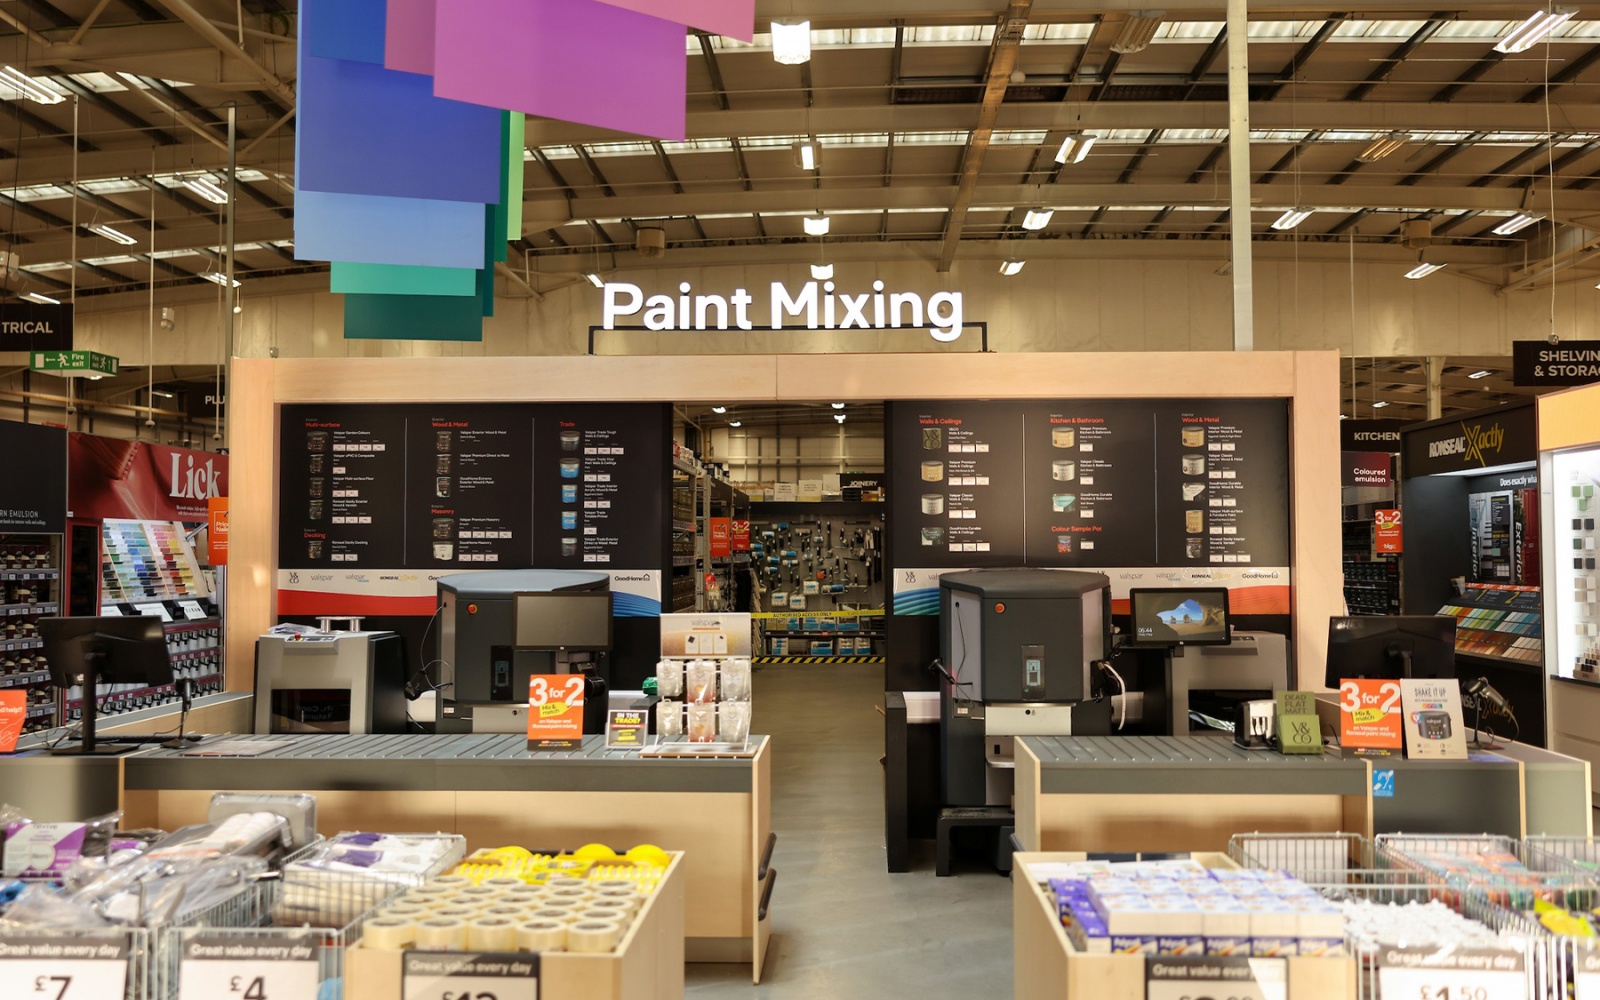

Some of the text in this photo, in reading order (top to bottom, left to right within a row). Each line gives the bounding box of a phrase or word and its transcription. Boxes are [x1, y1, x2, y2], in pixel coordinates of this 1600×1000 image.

[603, 280, 963, 342] Paint Mixing
[2, 322, 53, 334] TRICAL
[1540, 350, 1600, 362] SHELVIN
[1534, 366, 1600, 376] & STORA
[1354, 432, 1400, 440] KITCHEN
[1429, 421, 1504, 468] RONSEAL Xactly
[169, 452, 221, 500] Lick
[1500, 476, 1526, 486] Does exactly
[1375, 511, 1384, 524] 3
[1392, 511, 1401, 524] 2
[732, 521, 750, 531] 3 2
[1119, 572, 1143, 580] valspar
[529, 677, 585, 707] 3 for 2
[1340, 682, 1401, 713] 3 for 2
[1414, 687, 1446, 697] SHAKE IT UP
[1292, 722, 1310, 734] V&
[1293, 734, 1312, 744] CO
[0, 942, 120, 958] Great value every day
[190, 943, 312, 958] Great value every day
[1387, 950, 1517, 970] Great every day
[410, 960, 532, 975] Great value every day
[1152, 964, 1221, 976] Great value
[35, 975, 74, 1000] £7
[229, 975, 268, 1000] £4
